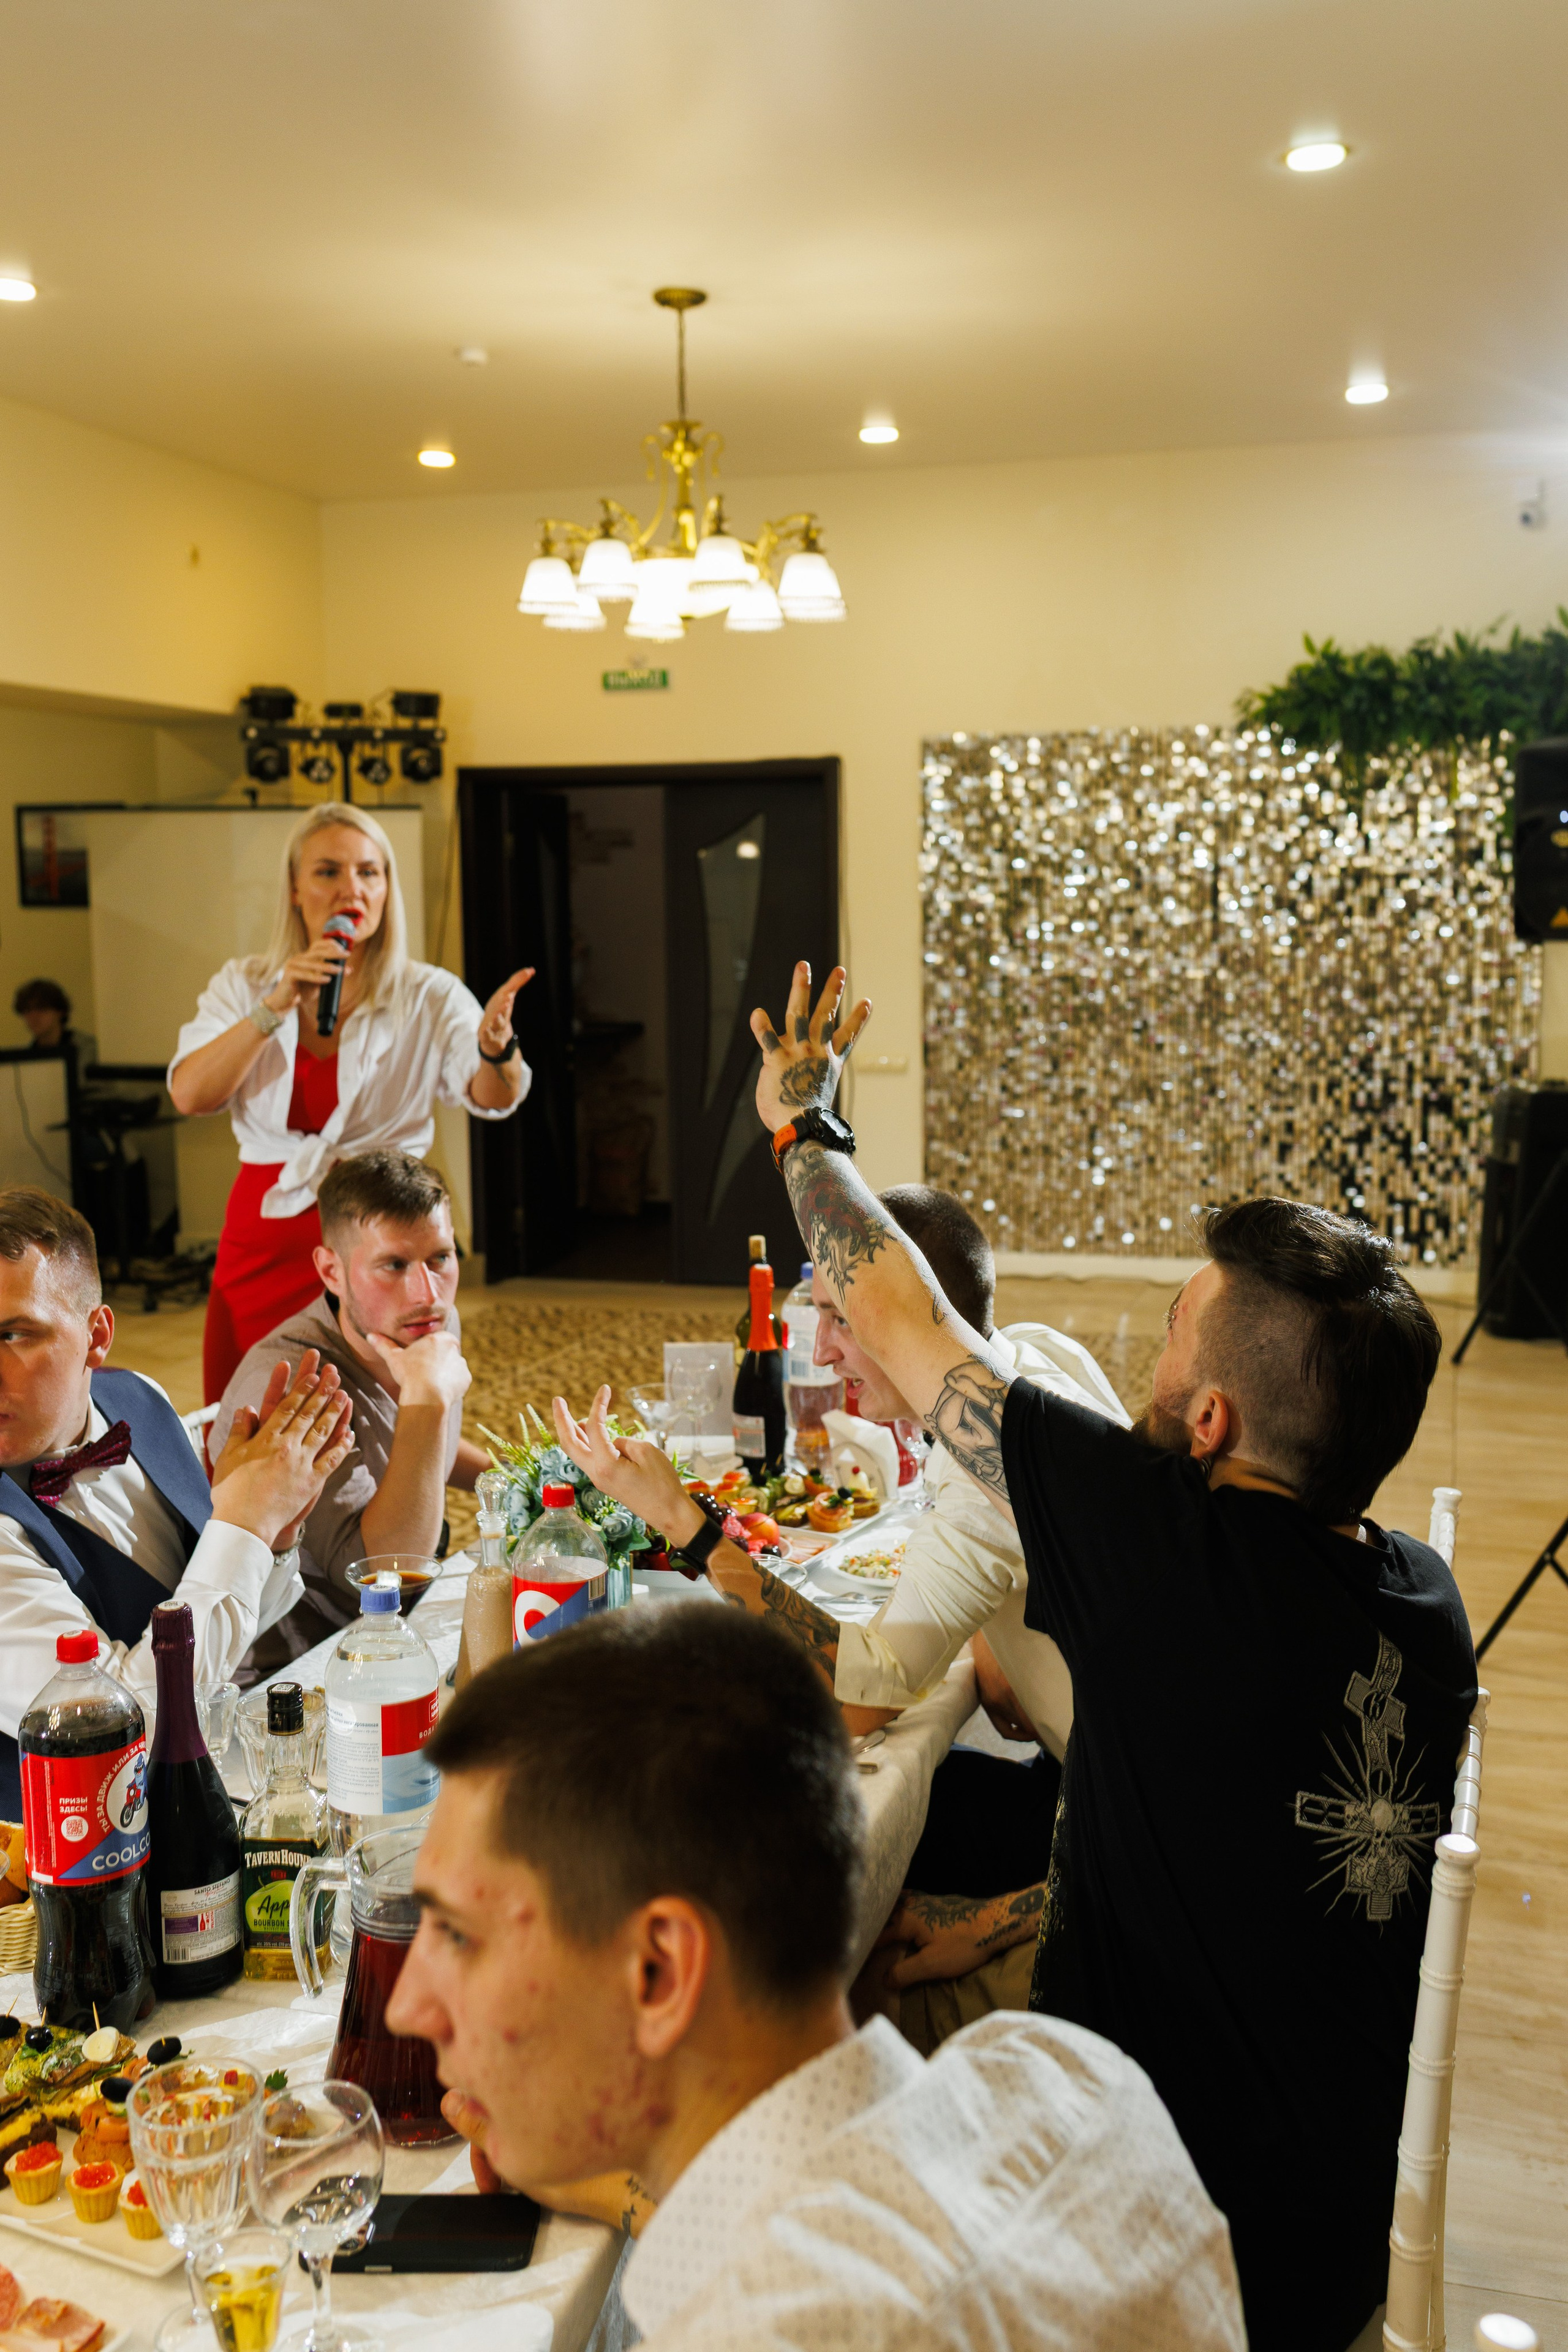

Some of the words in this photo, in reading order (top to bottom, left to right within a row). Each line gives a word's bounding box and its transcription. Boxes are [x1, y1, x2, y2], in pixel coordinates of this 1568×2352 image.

[129, 1746, 139, 1757] ЗА
[112, 1753, 130, 1773] ИЛИ
[97, 1772, 114, 1803] ДВИЖ
[59, 1805, 88, 1814] ЗДЕСЬ!
[97, 1805, 105, 1819] ЗА
[99, 1818, 111, 1833] ТЫ
[194, 1886, 211, 1895] SANTO
[212, 1878, 230, 1890] STEFANO
[257, 1894, 290, 1920] App
